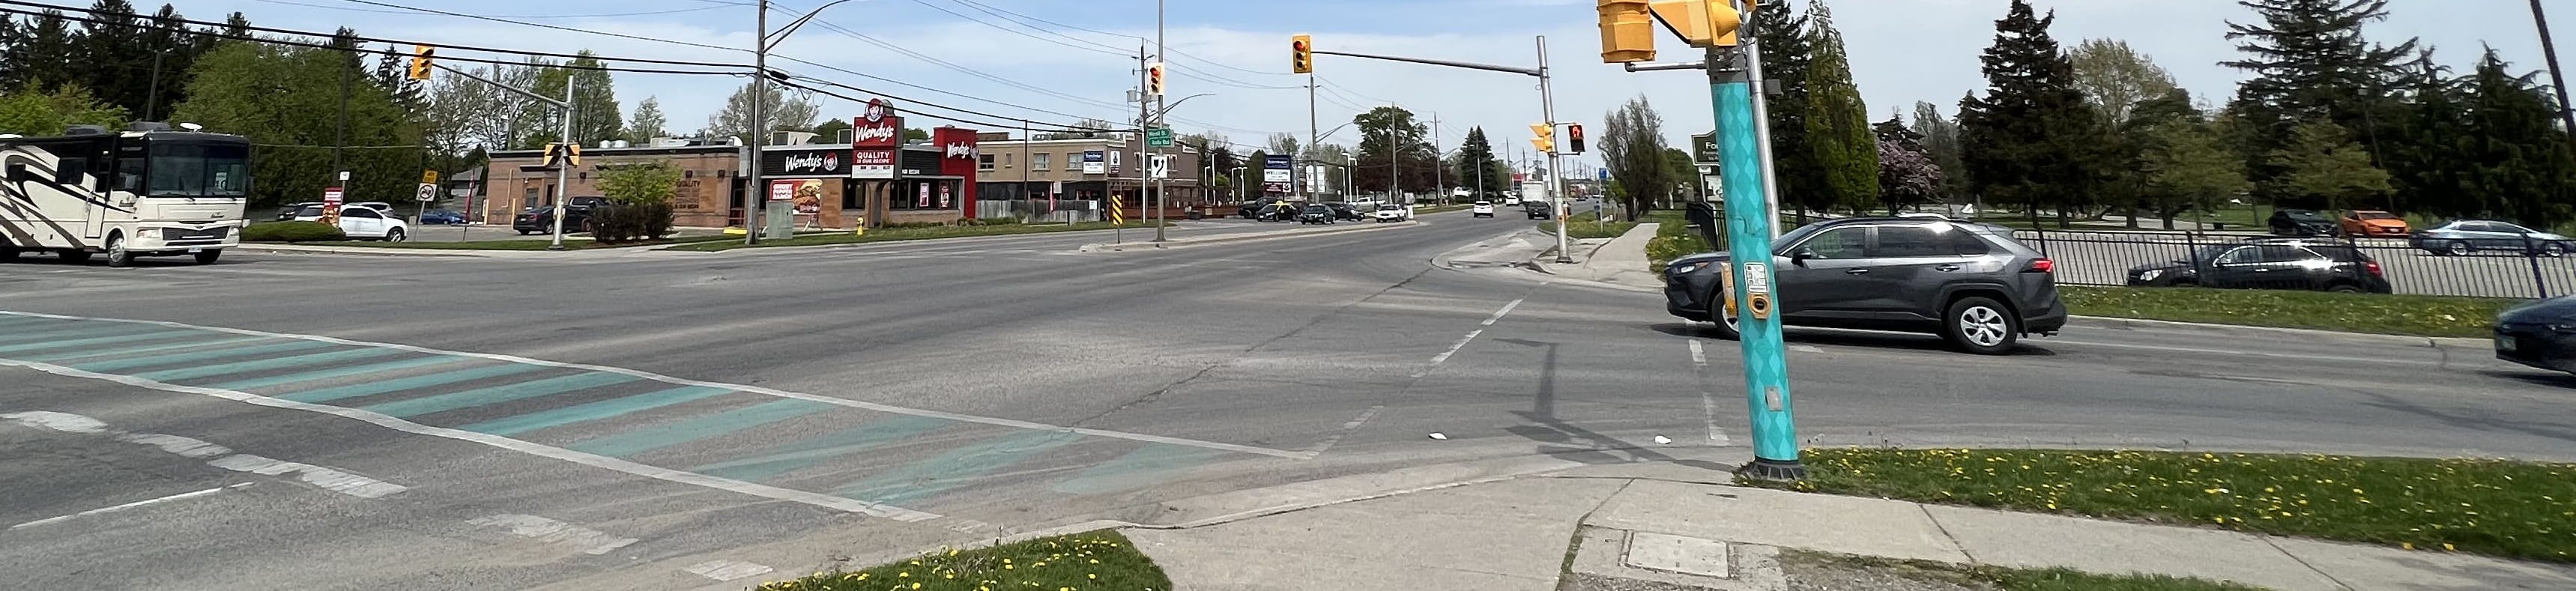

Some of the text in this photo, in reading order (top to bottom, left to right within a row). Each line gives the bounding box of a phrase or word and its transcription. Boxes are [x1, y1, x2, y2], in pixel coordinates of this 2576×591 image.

[855, 121, 895, 143] Wendy's
[947, 141, 970, 160] Wendy's
[785, 152, 823, 172] Wendy's
